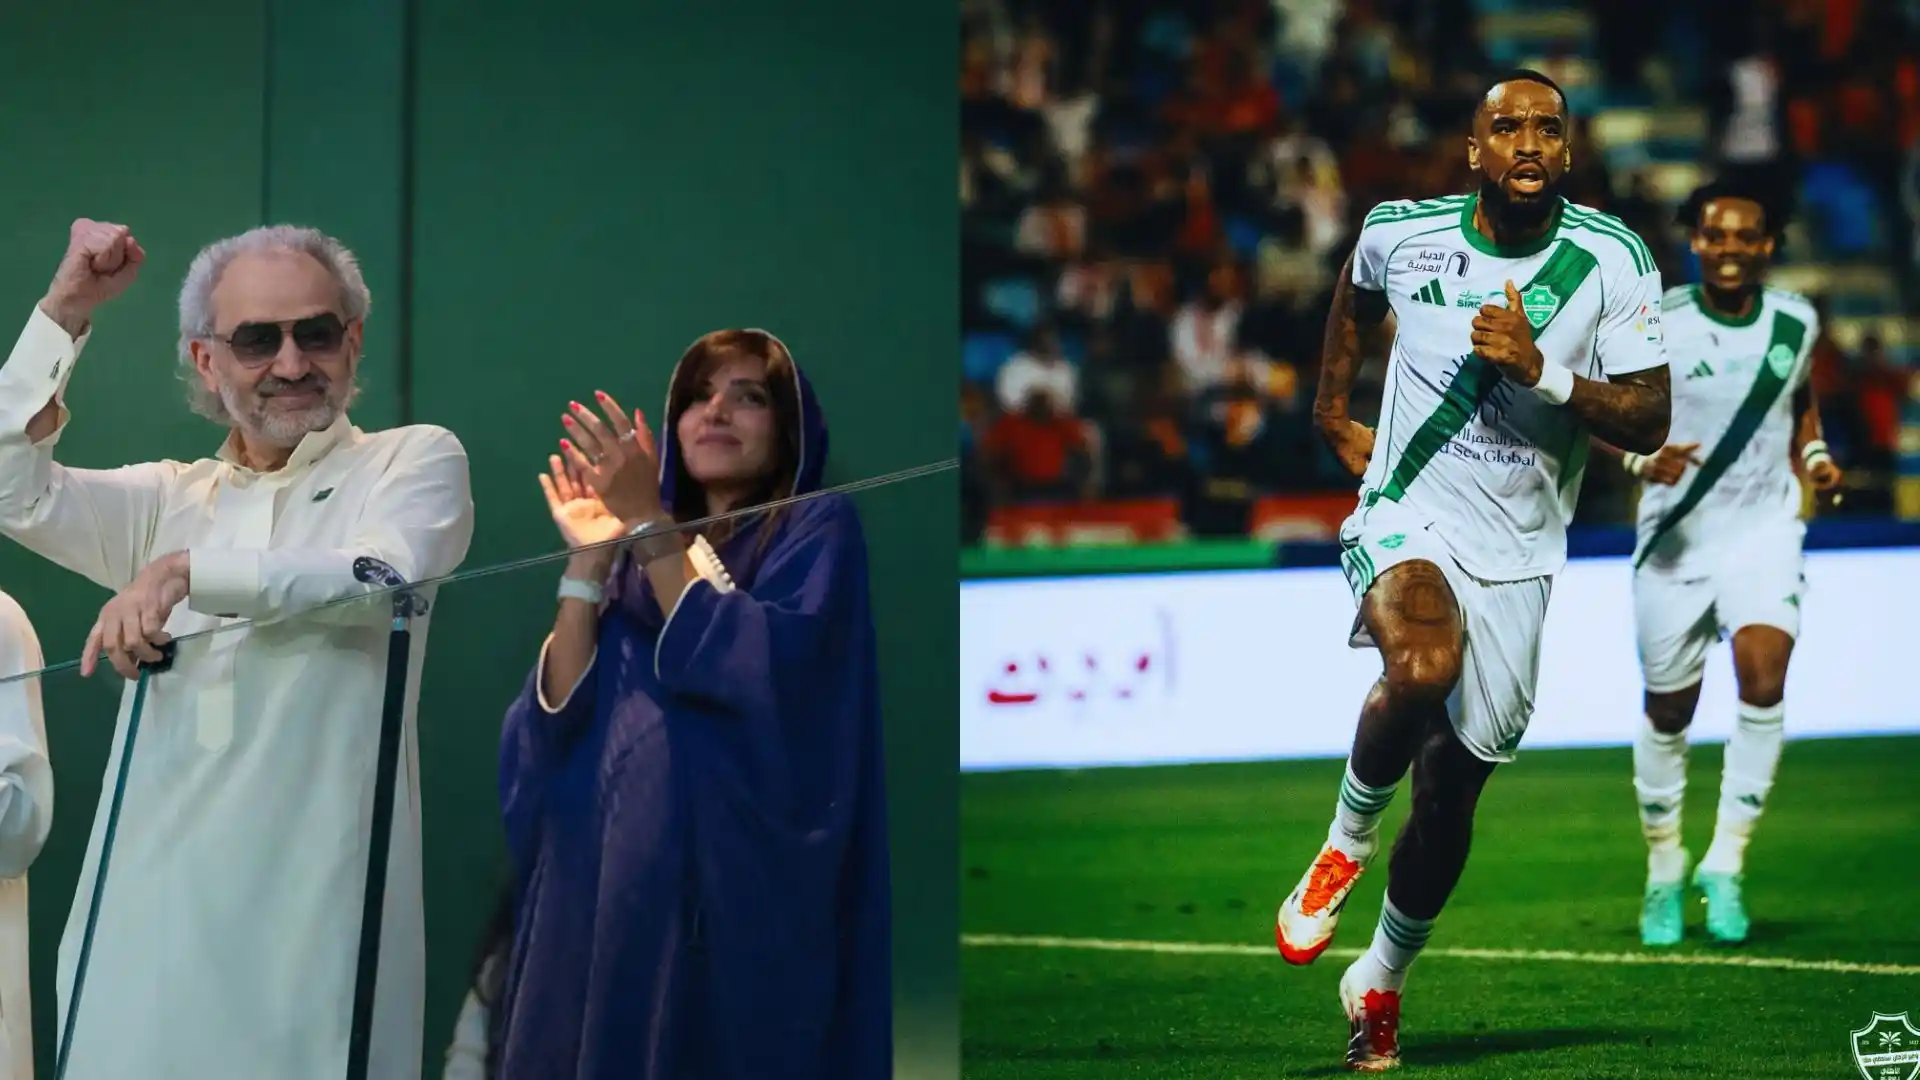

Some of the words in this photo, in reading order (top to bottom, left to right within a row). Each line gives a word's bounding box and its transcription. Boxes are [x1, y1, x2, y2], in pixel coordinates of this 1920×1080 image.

[1419, 250, 1445, 261] الديار
[1408, 260, 1441, 272] العربية
[1457, 299, 1481, 309] SIRC
[1453, 443, 1480, 461] Sea
[1483, 449, 1535, 466] Global
